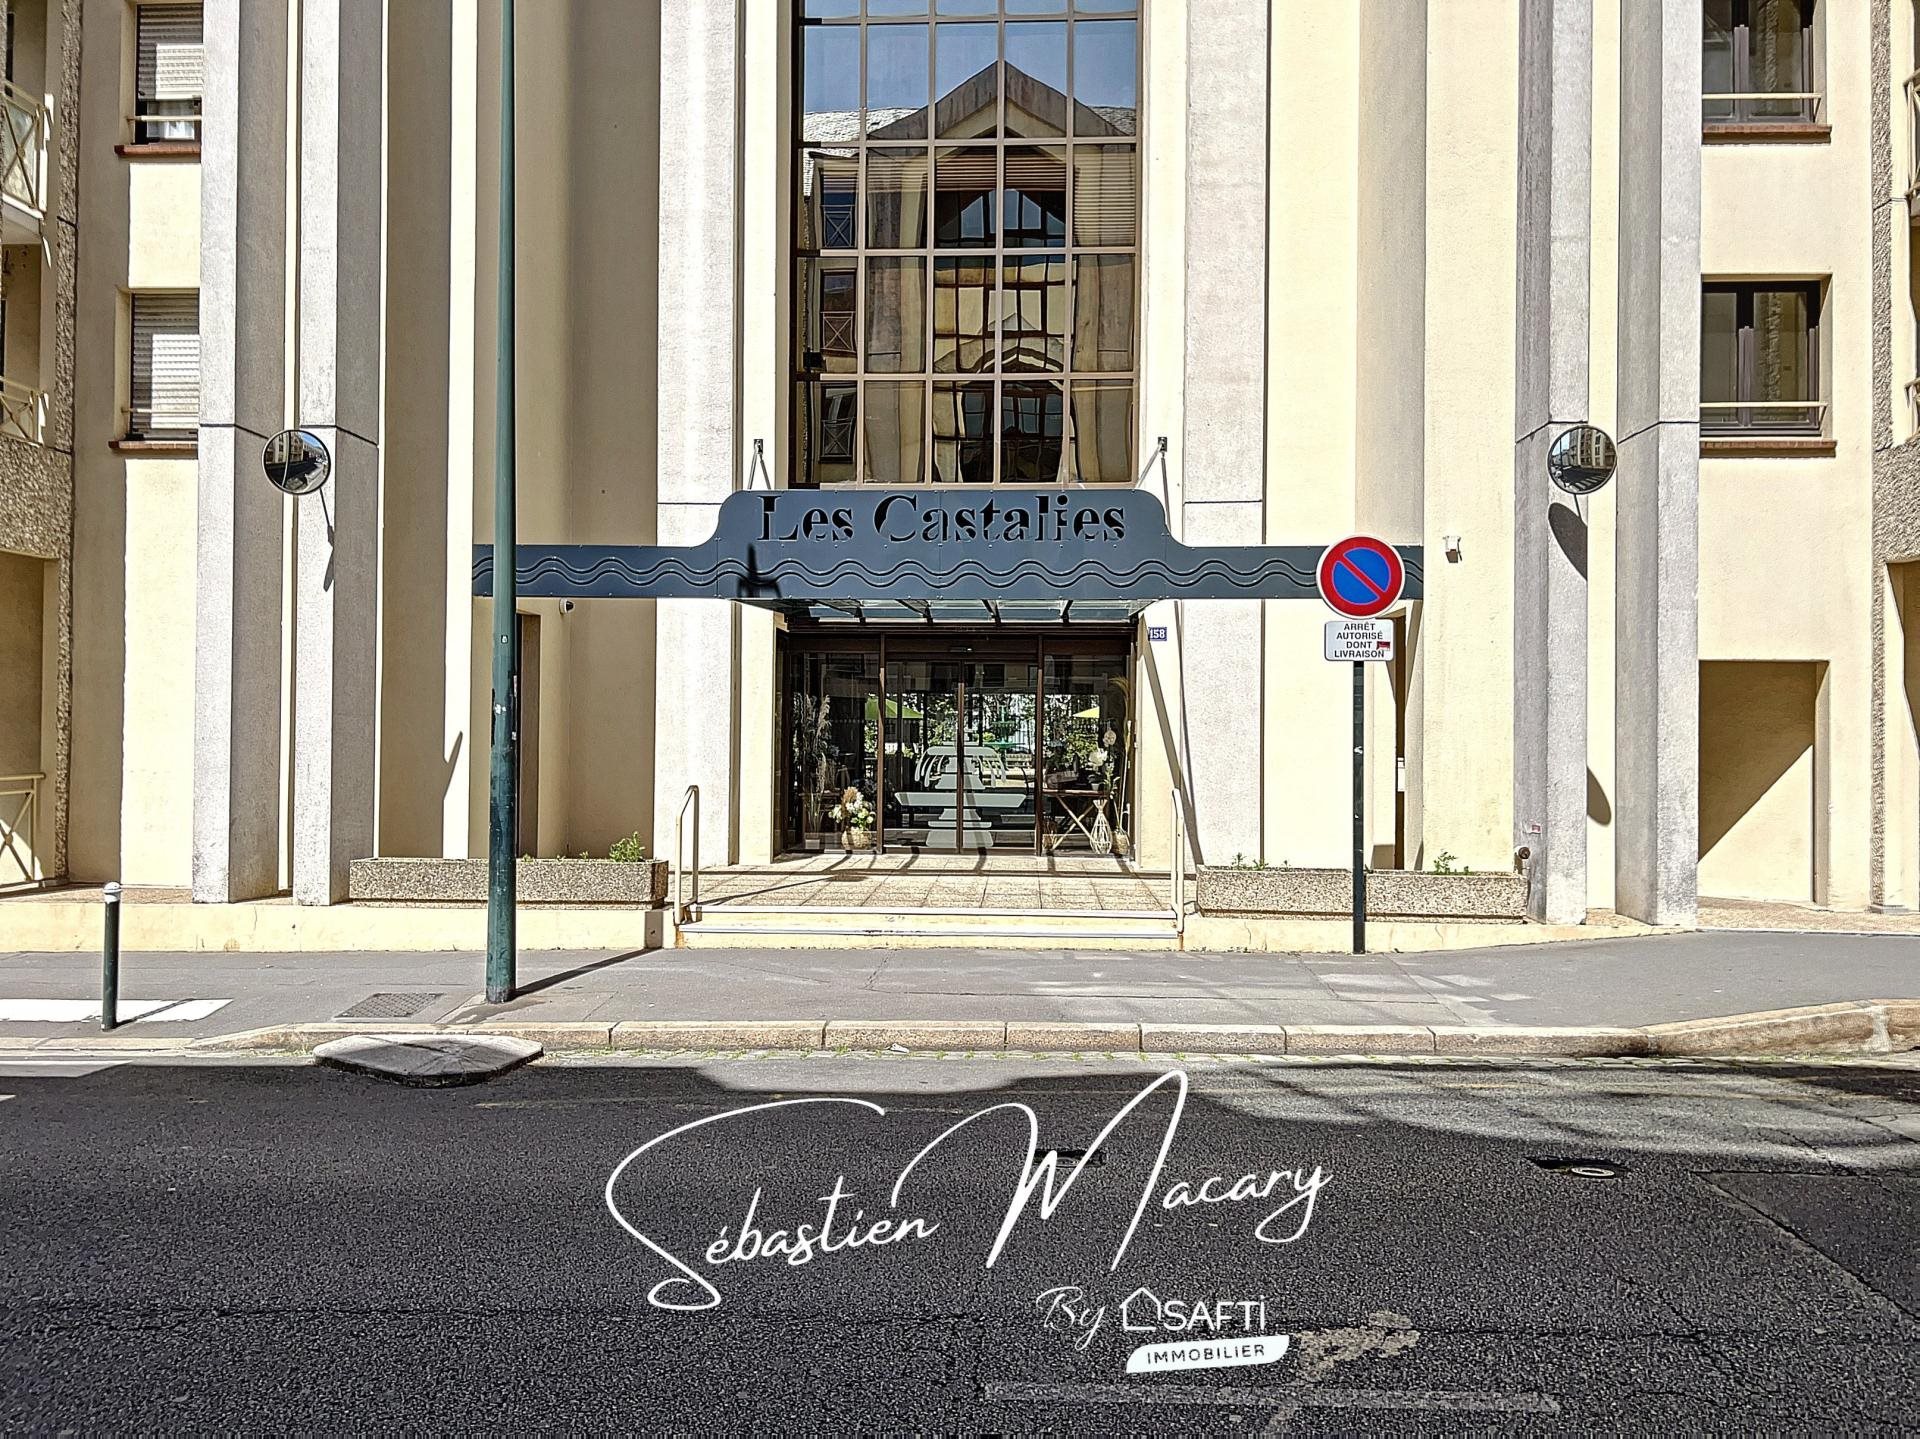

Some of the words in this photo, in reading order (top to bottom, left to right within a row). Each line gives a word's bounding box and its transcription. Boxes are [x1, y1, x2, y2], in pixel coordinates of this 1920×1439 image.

[756, 494, 855, 542] Les
[873, 494, 1126, 542] Castalies
[1344, 621, 1376, 631] ARRÊT
[1149, 628, 1166, 639] 158
[1336, 630, 1384, 640] AUTORISÉ
[1346, 640, 1373, 649] DONT
[1334, 649, 1385, 658] LIVRAISON
